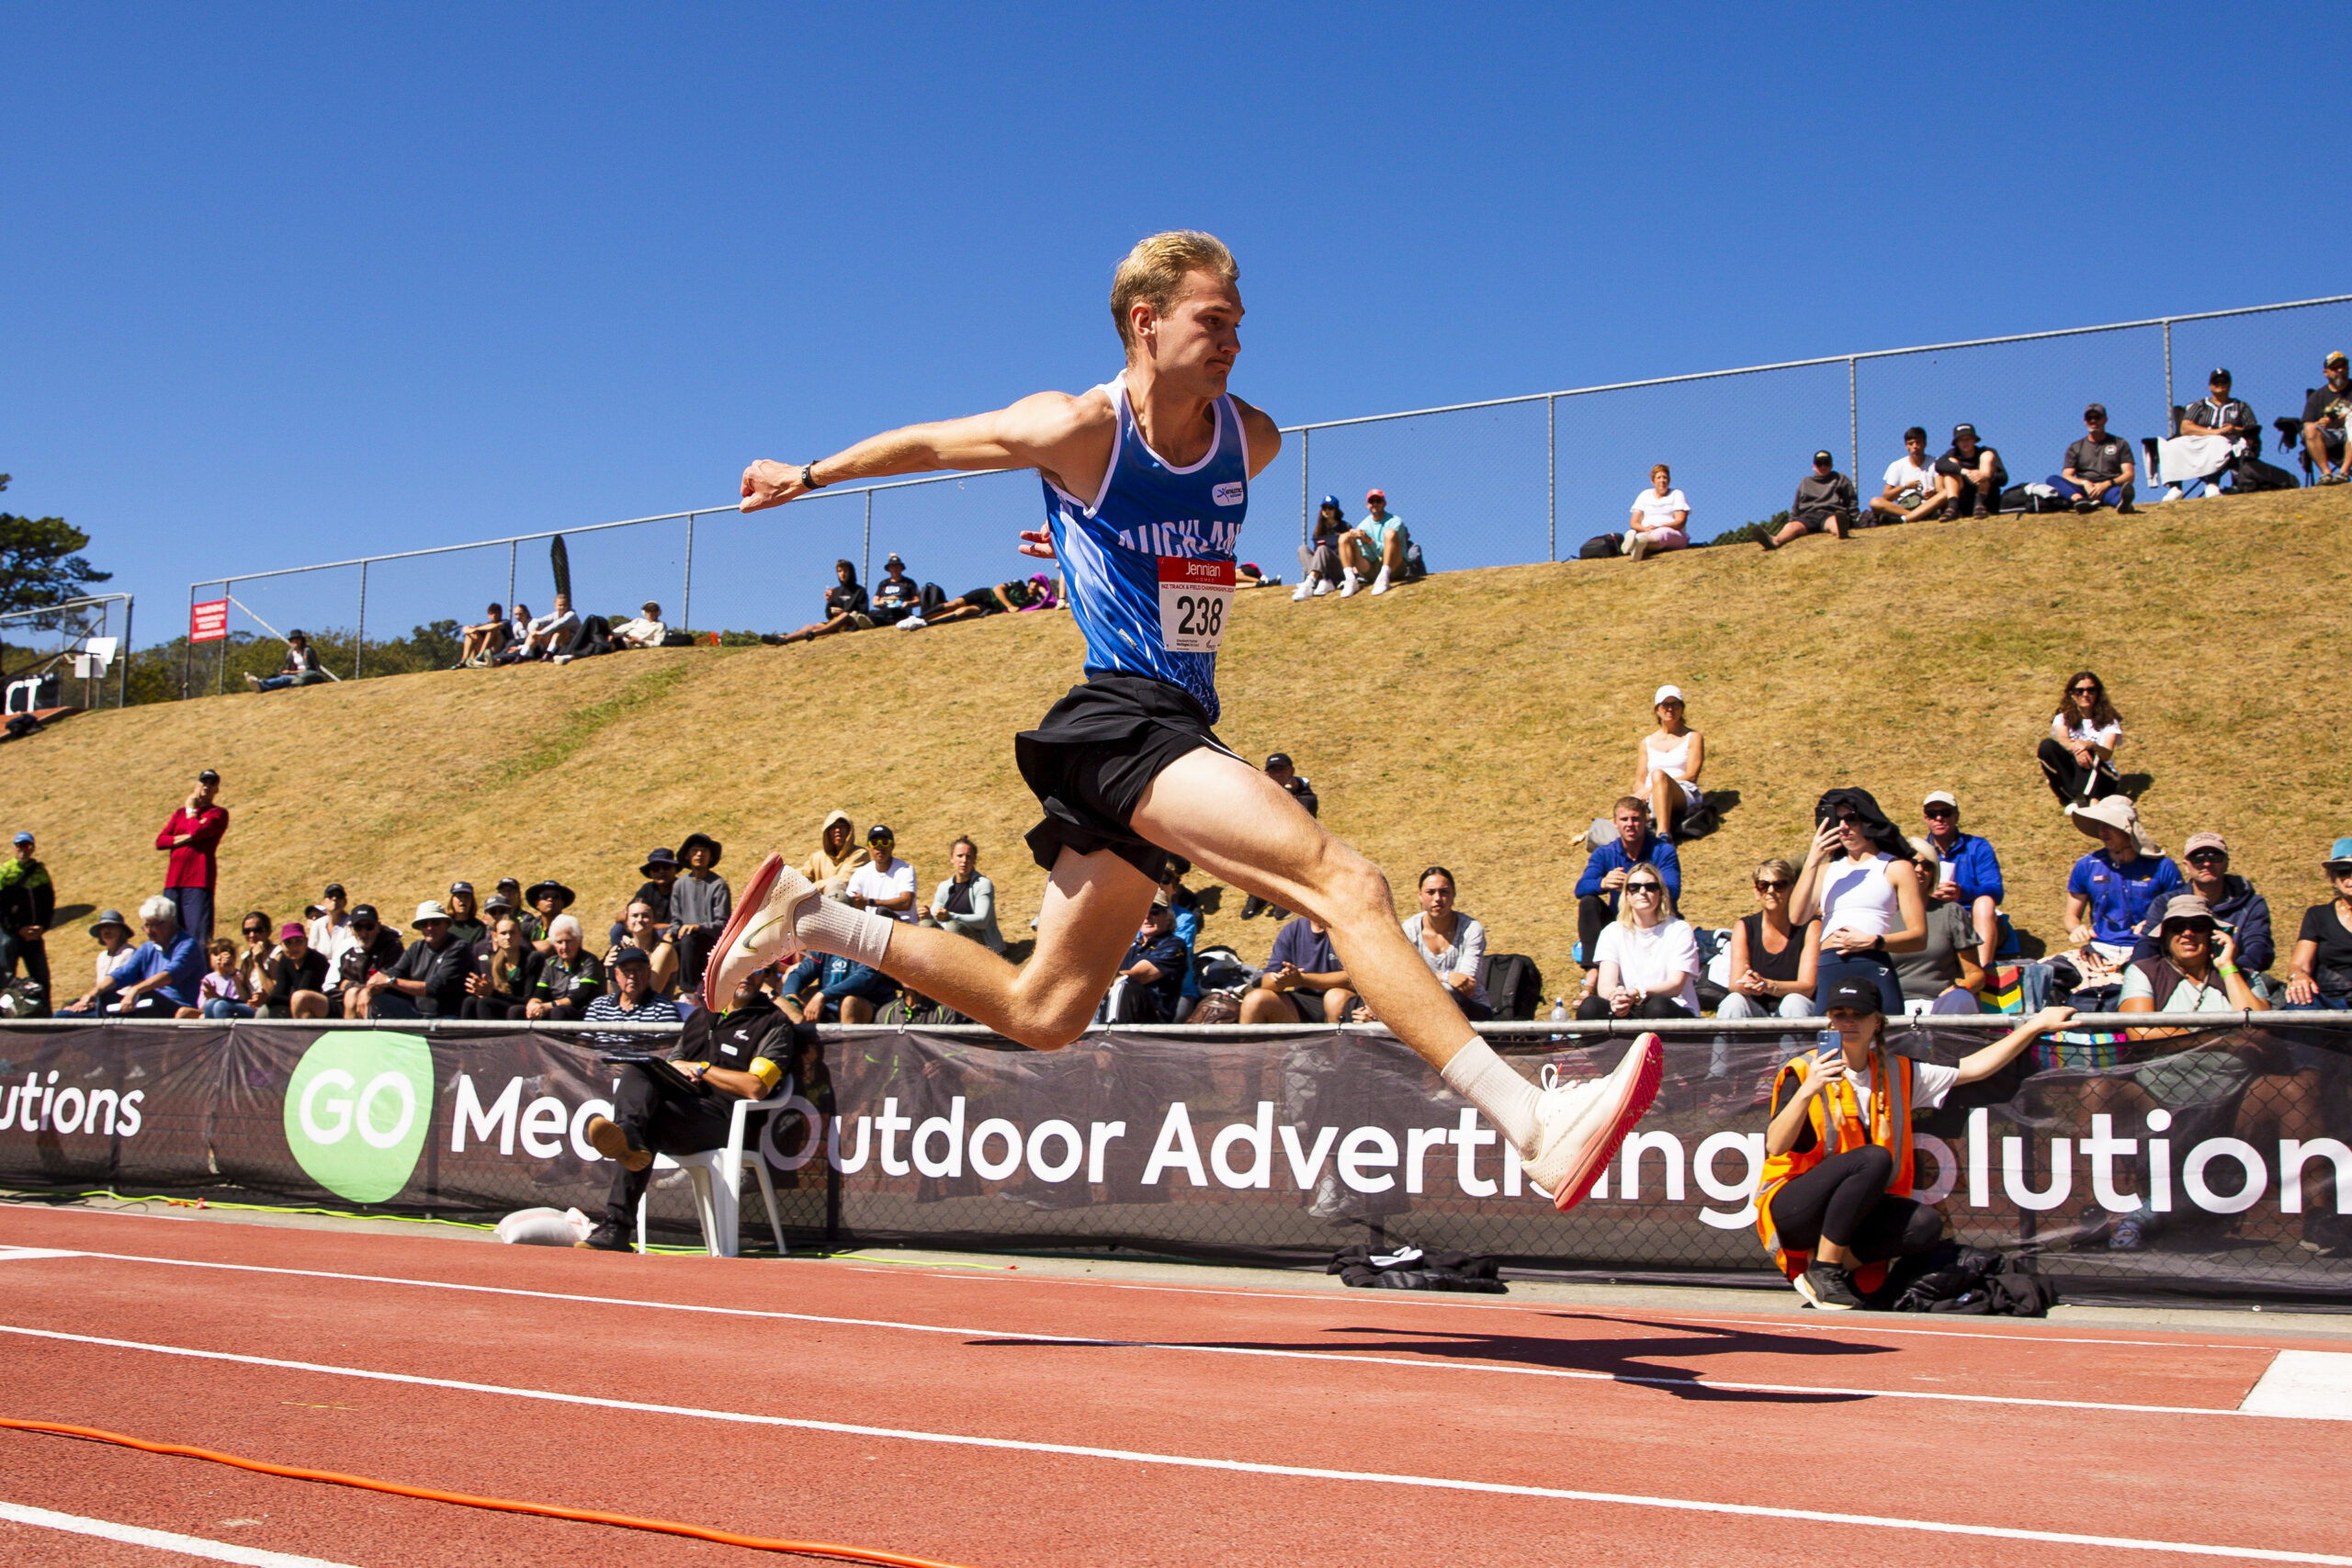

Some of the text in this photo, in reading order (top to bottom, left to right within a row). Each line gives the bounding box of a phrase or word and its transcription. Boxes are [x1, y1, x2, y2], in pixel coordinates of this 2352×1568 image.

[1185, 561, 1221, 577] Jennian
[1177, 595, 1223, 637] 238
[299, 1068, 416, 1148] GO
[760, 1095, 1126, 1183] Outdoor
[1912, 1107, 2352, 1214] olution
